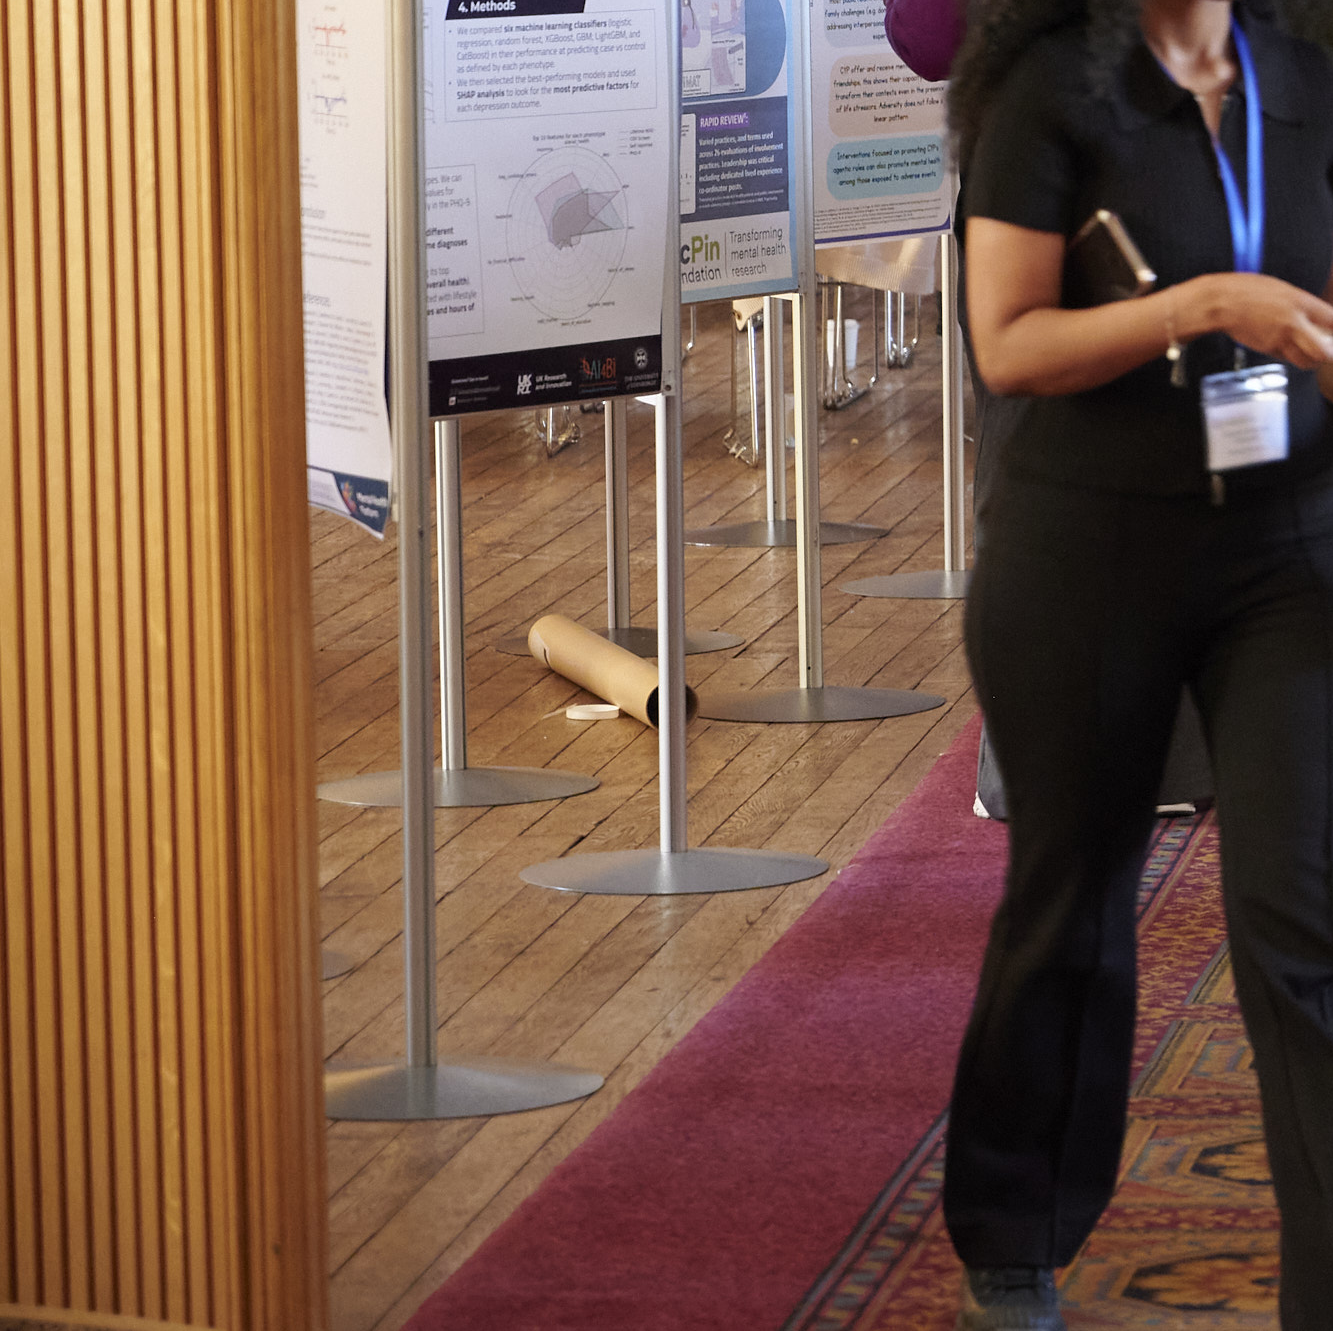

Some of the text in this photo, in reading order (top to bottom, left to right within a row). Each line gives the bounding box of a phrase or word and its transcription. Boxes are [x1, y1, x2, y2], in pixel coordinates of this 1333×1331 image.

[470, 0, 516, 12] Methods
[730, 227, 782, 243] Transforming
[681, 235, 720, 264] cPin
[761, 244, 786, 256] health
[682, 266, 721, 284] ndation
[731, 264, 767, 278] research
[518, 375, 532, 386] UK
